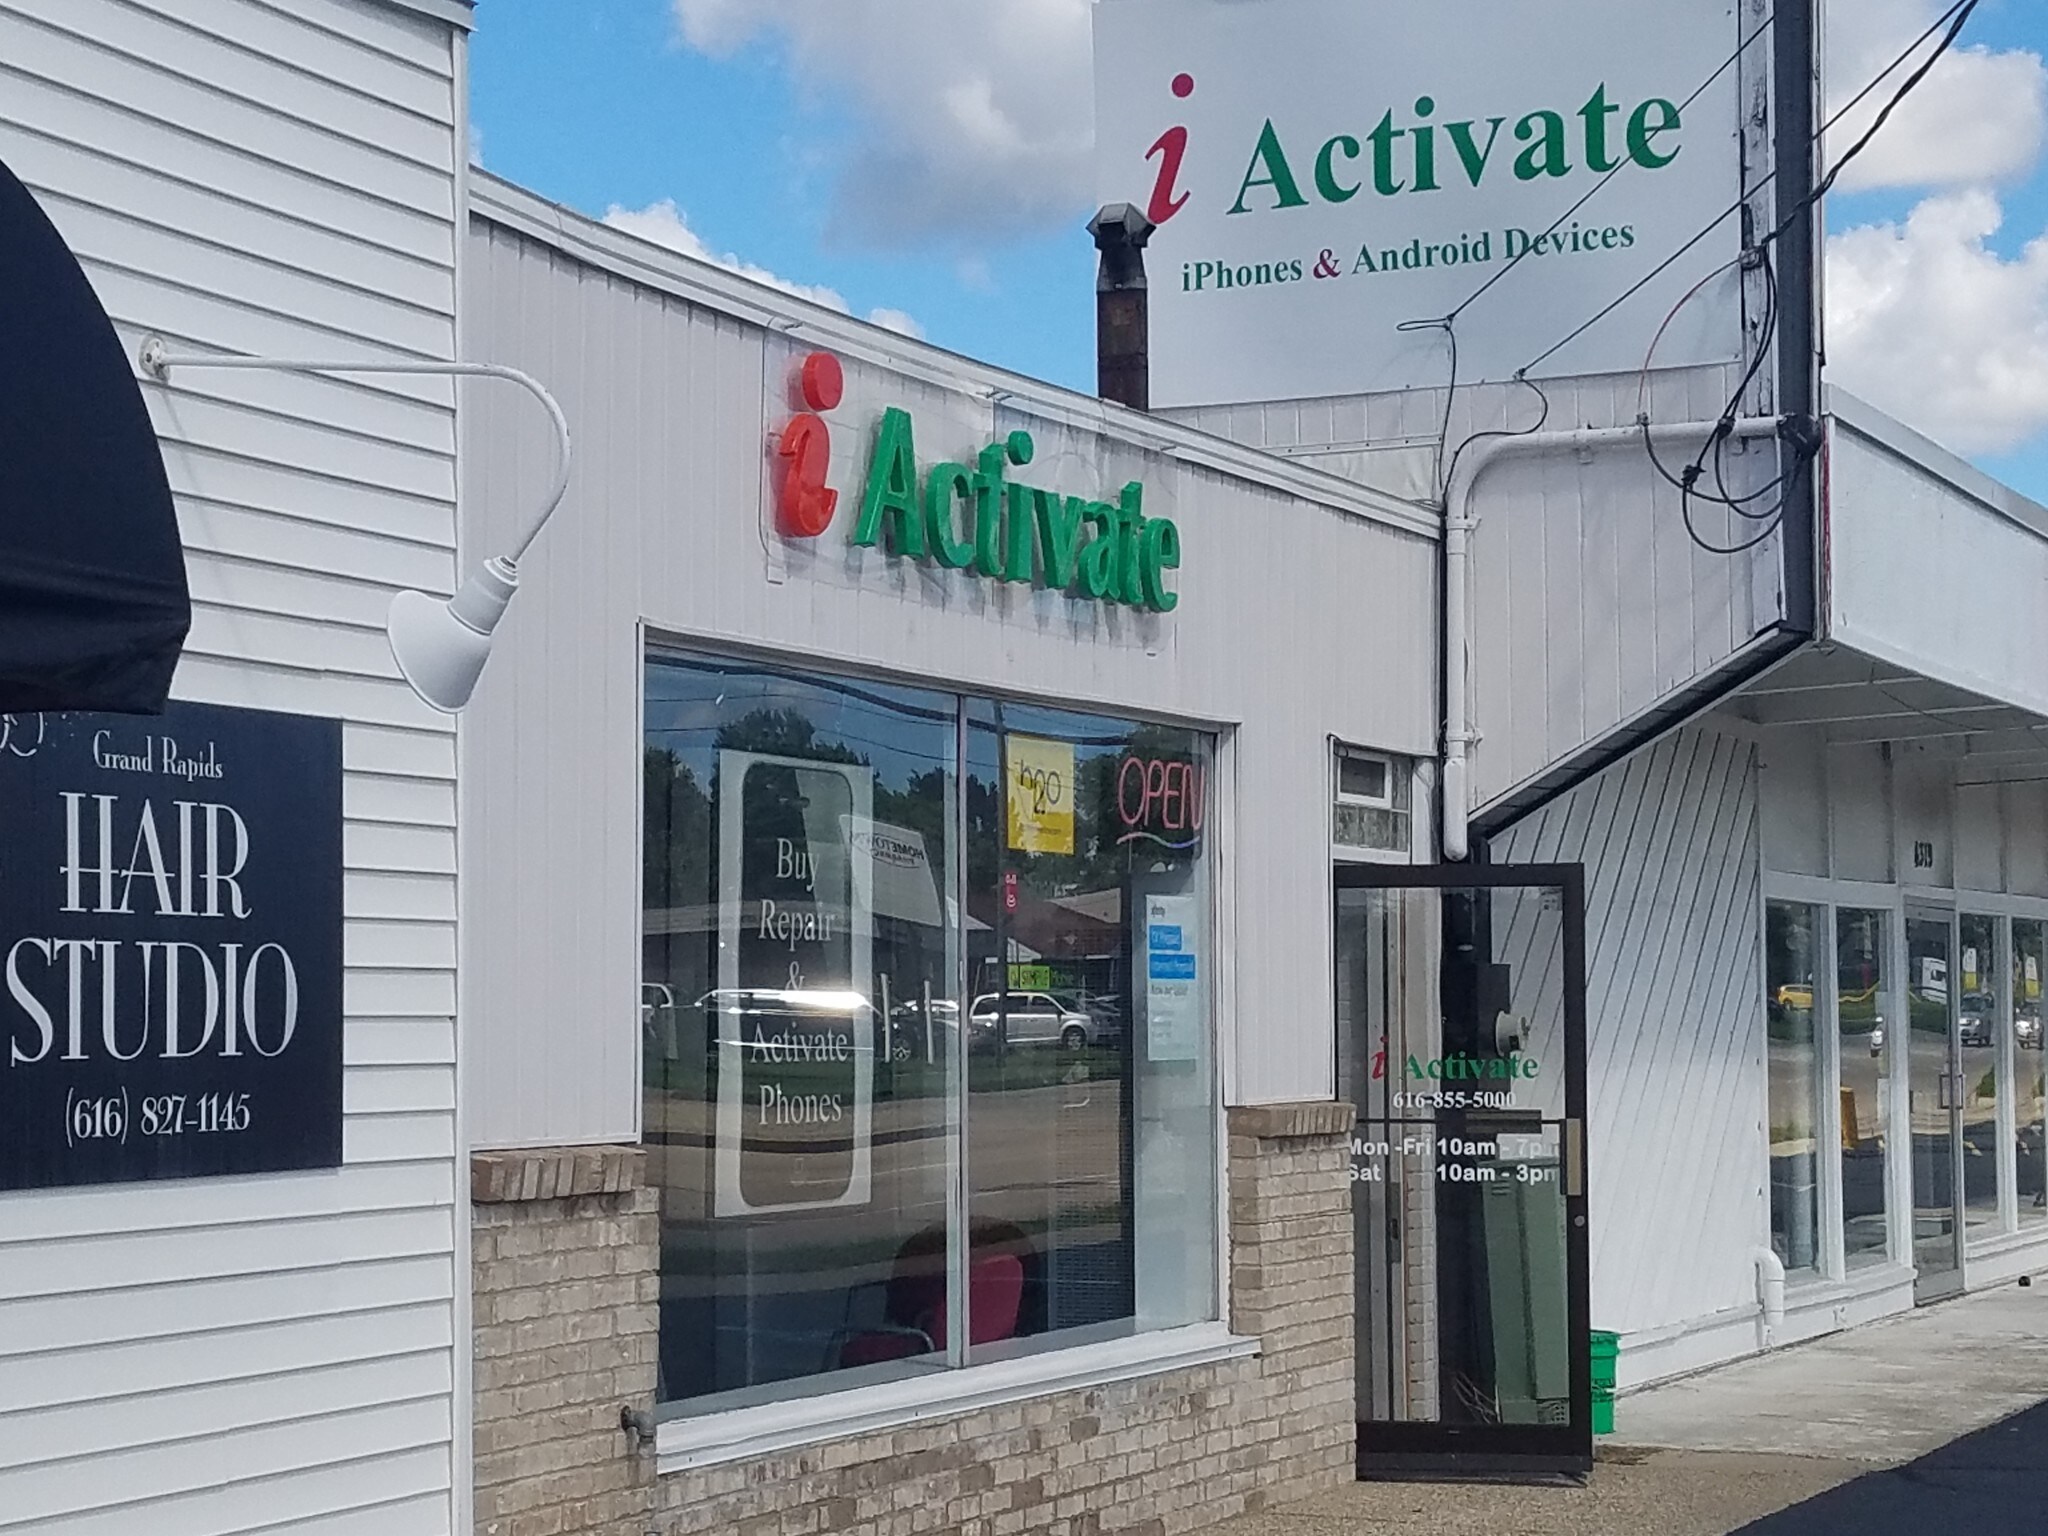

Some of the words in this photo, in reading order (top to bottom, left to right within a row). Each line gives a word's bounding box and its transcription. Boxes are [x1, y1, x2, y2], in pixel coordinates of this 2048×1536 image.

[1145, 73, 1194, 224] i
[1226, 81, 1682, 215] Activate
[1182, 257, 1302, 291] iPhones
[1313, 248, 1341, 278] &
[1352, 231, 1490, 274] Android
[1504, 220, 1635, 258] Devices
[778, 351, 843, 538] i
[853, 406, 1180, 612] Activate
[93, 730, 153, 773] Grand
[162, 736, 223, 783] Rapids
[1117, 756, 1206, 830] OPEN
[59, 791, 253, 919] HAIR
[776, 838, 820, 891] Buy
[759, 899, 835, 952] Repair
[6, 937, 298, 1067] STUDIO
[750, 1021, 848, 1063] Activate
[1404, 1051, 1539, 1080] Activate
[66, 1086, 128, 1147] (616)
[140, 1091, 251, 1137] 827-1145
[759, 1084, 842, 1126] Phones
[1393, 1091, 1517, 1108] 616-855-5000
[1349, 1164, 1382, 1181] Sat
[1437, 1164, 1496, 1181] 10am
[1350, 1138, 1389, 1155] Mon
[1437, 1138, 1496, 1155] 10am
